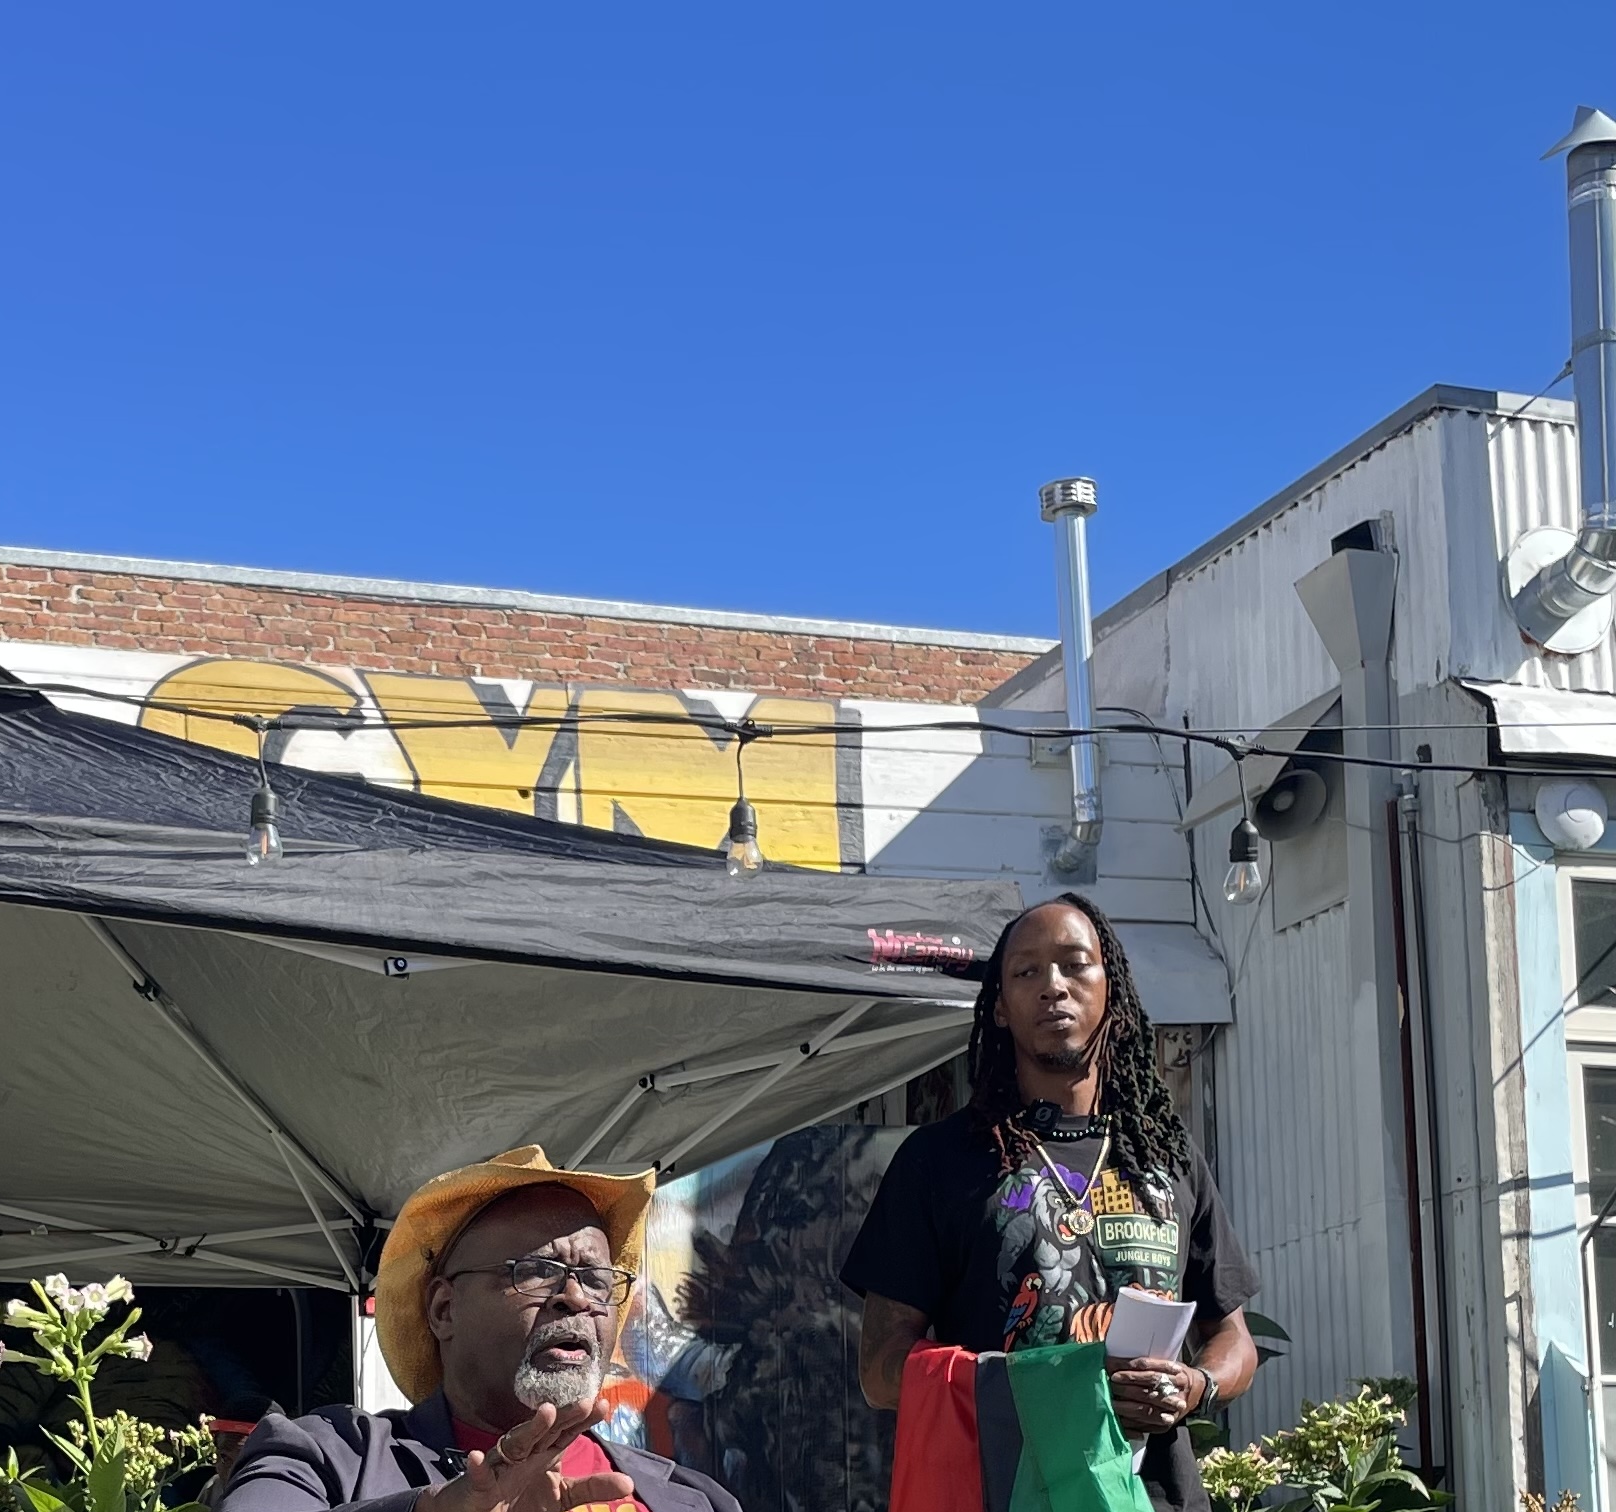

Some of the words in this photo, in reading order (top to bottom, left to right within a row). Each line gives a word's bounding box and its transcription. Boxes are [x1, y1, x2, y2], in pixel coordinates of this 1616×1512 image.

[1104, 1221, 1176, 1246] BROOKFIELD
[1115, 1250, 1150, 1263] JUNGLE
[1151, 1252, 1171, 1267] BOYS
